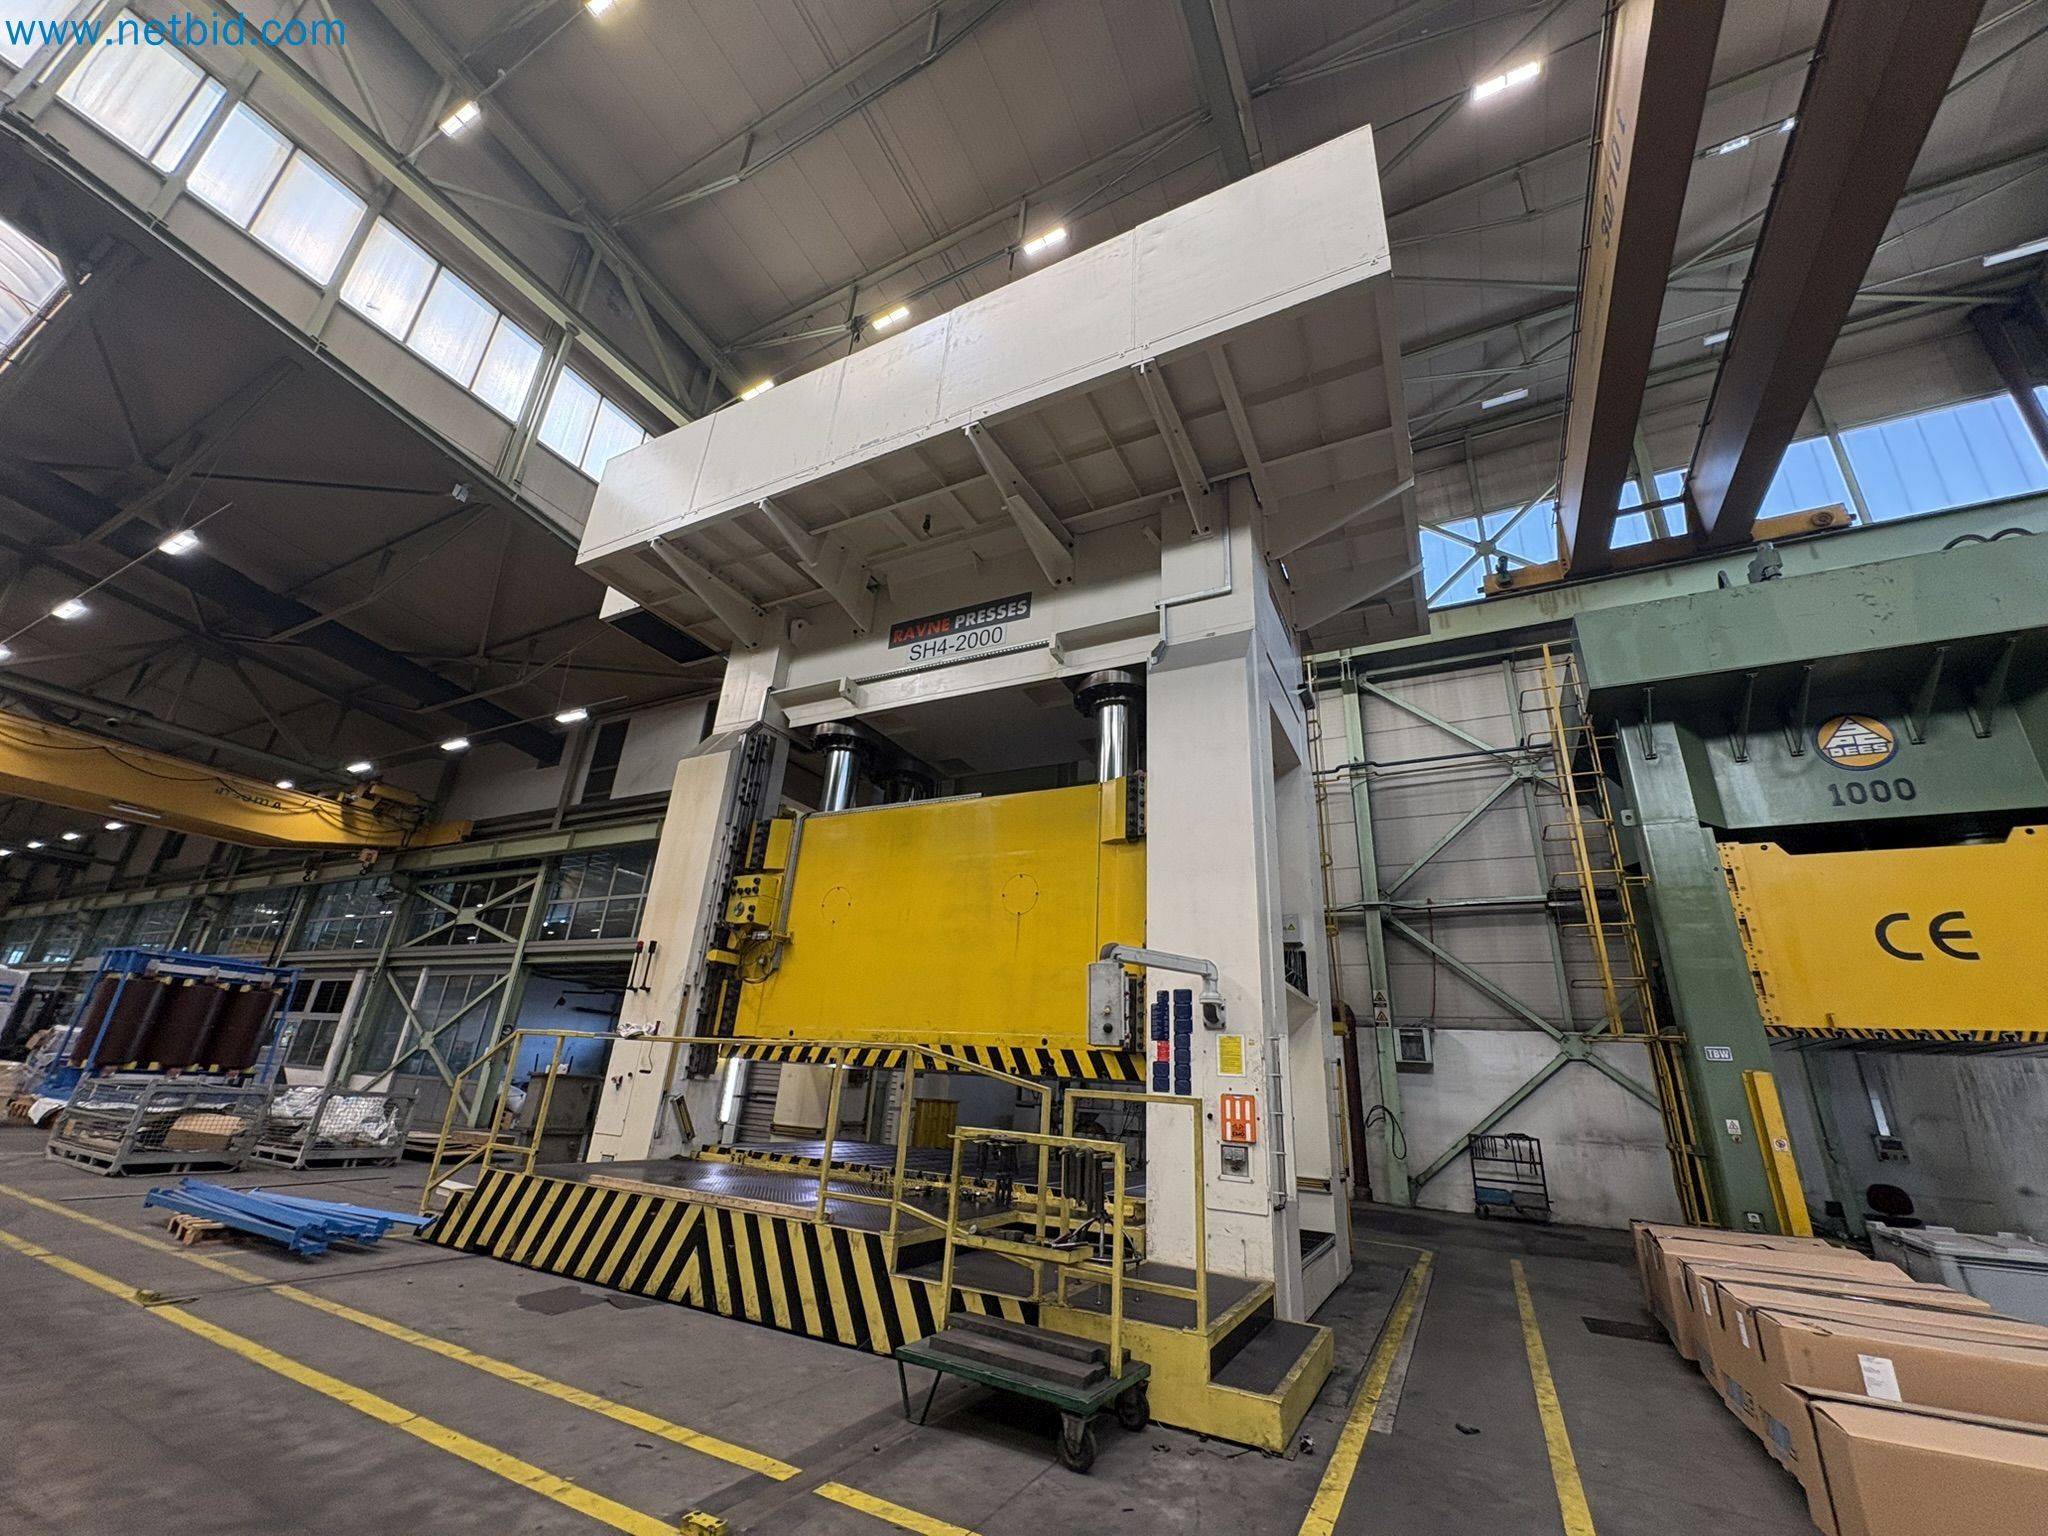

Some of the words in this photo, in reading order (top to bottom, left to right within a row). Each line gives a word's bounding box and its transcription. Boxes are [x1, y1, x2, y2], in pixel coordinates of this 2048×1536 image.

[893, 617, 950, 644] RAVNE
[954, 599, 1028, 629] PRESSES
[909, 626, 1003, 661] SH4-2000
[1829, 742, 1889, 757] DEES
[1828, 777, 1917, 807] 1000
[1874, 910, 1981, 961] CE
[1707, 1048, 1730, 1059] TBW
